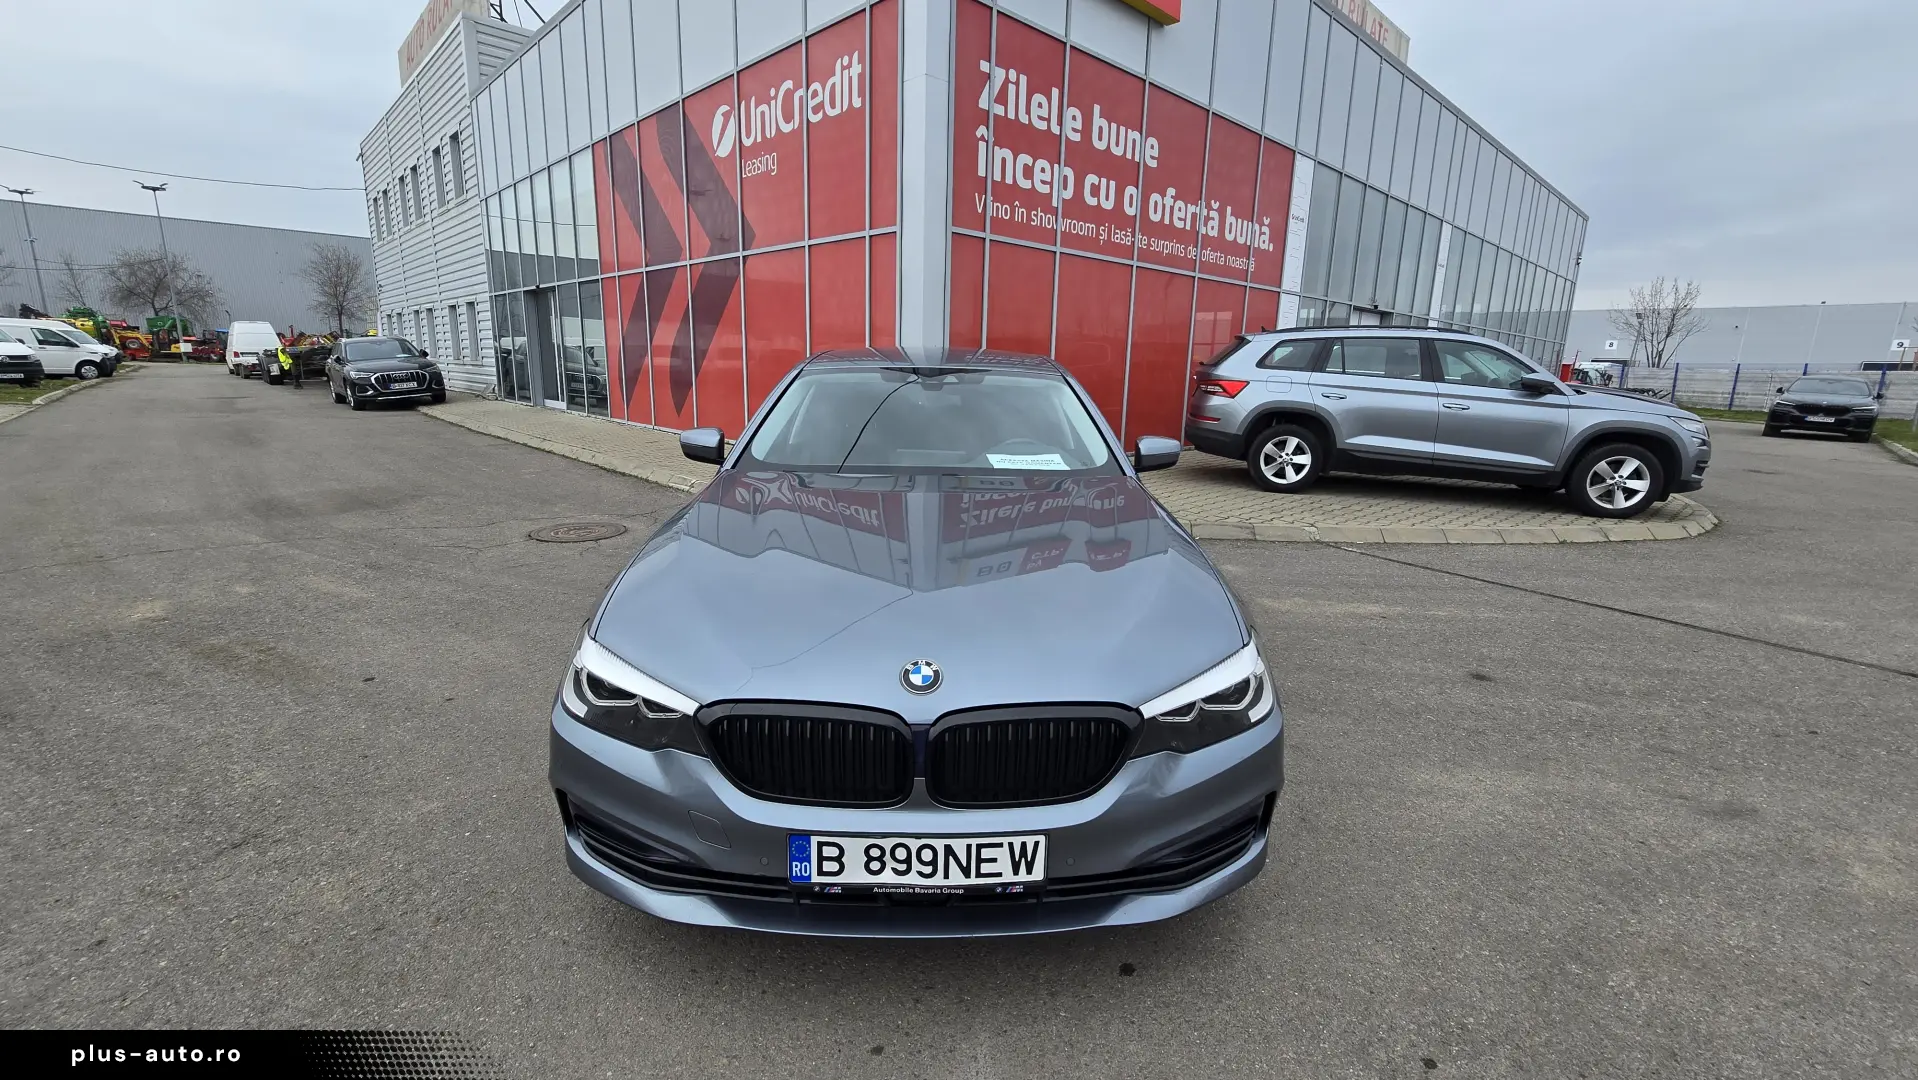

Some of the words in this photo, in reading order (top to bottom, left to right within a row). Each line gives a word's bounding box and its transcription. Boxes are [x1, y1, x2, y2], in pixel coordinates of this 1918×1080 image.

[741, 51, 862, 146] UniCredit
[978, 59, 1083, 142] Zilele
[1092, 103, 1159, 168] bune
[742, 152, 777, 178] Leasing
[975, 192, 1011, 220] Vino
[1014, 200, 1027, 223] în
[1031, 207, 1096, 238] showroom
[1099, 223, 1109, 245] și
[1150, 239, 1185, 257] surprins
[1187, 246, 1198, 260] de
[1201, 248, 1225, 265] oferta
[1084, 173, 1116, 210] cu
[1124, 185, 1138, 216] o
[1149, 187, 1220, 237] ofertă
[1225, 206, 1274, 252] bună.
[792, 862, 810, 876] RO
[817, 840, 846, 877] B
[864, 841, 1041, 879] 899NEW
[942, 887, 965, 895] Group
